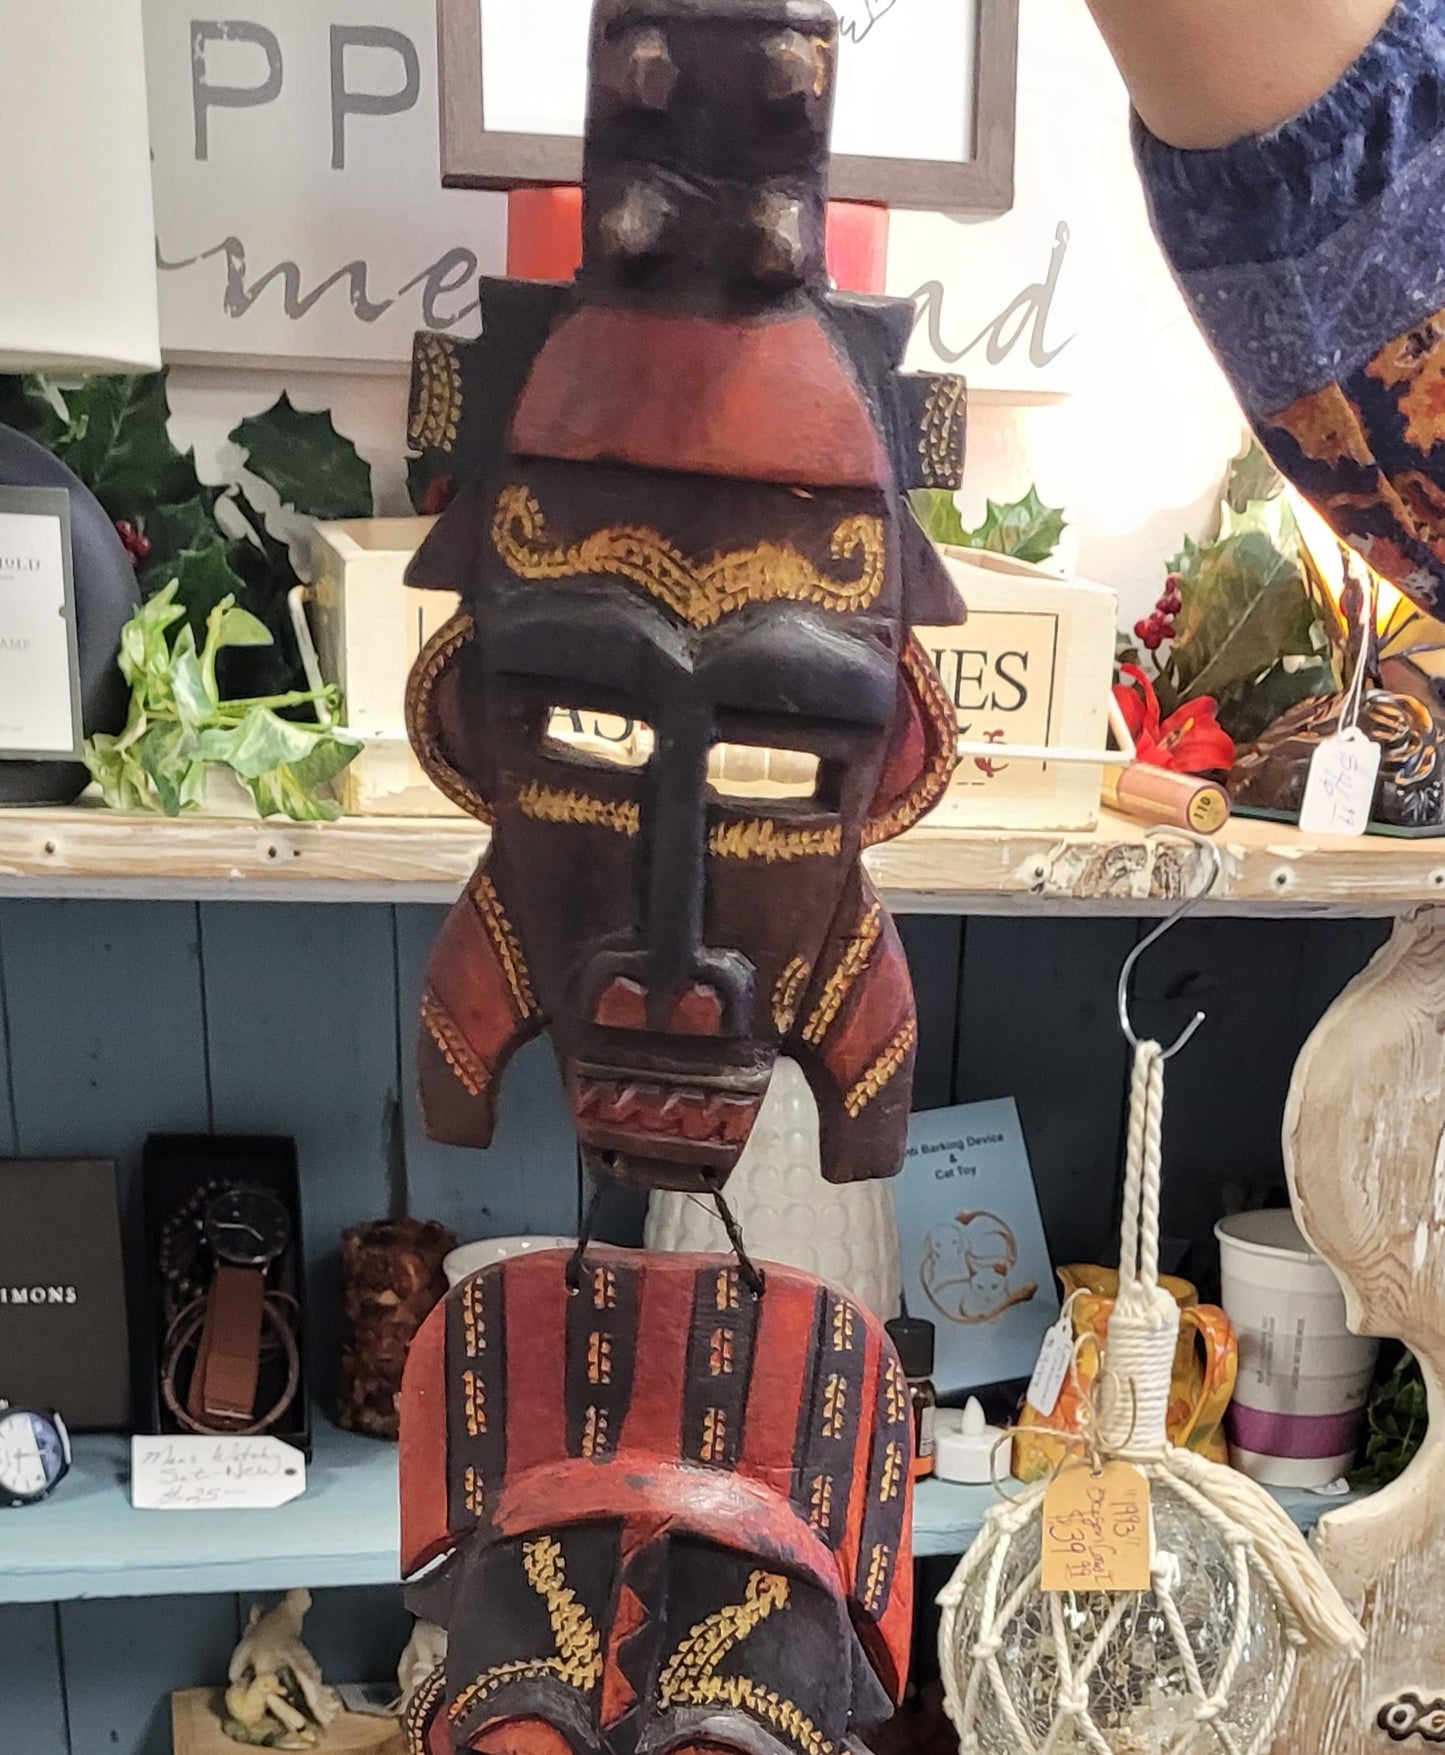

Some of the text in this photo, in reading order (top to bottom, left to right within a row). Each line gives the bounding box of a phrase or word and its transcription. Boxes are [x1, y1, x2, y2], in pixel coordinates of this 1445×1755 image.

[150, 20, 420, 170] PP
[155, 235, 482, 330] me
[921, 1140, 965, 1155] Barking
[966, 1133, 1005, 1148] Device
[935, 1166, 977, 1180] Cat Toy
[0, 1286, 77, 1304] IMONS
